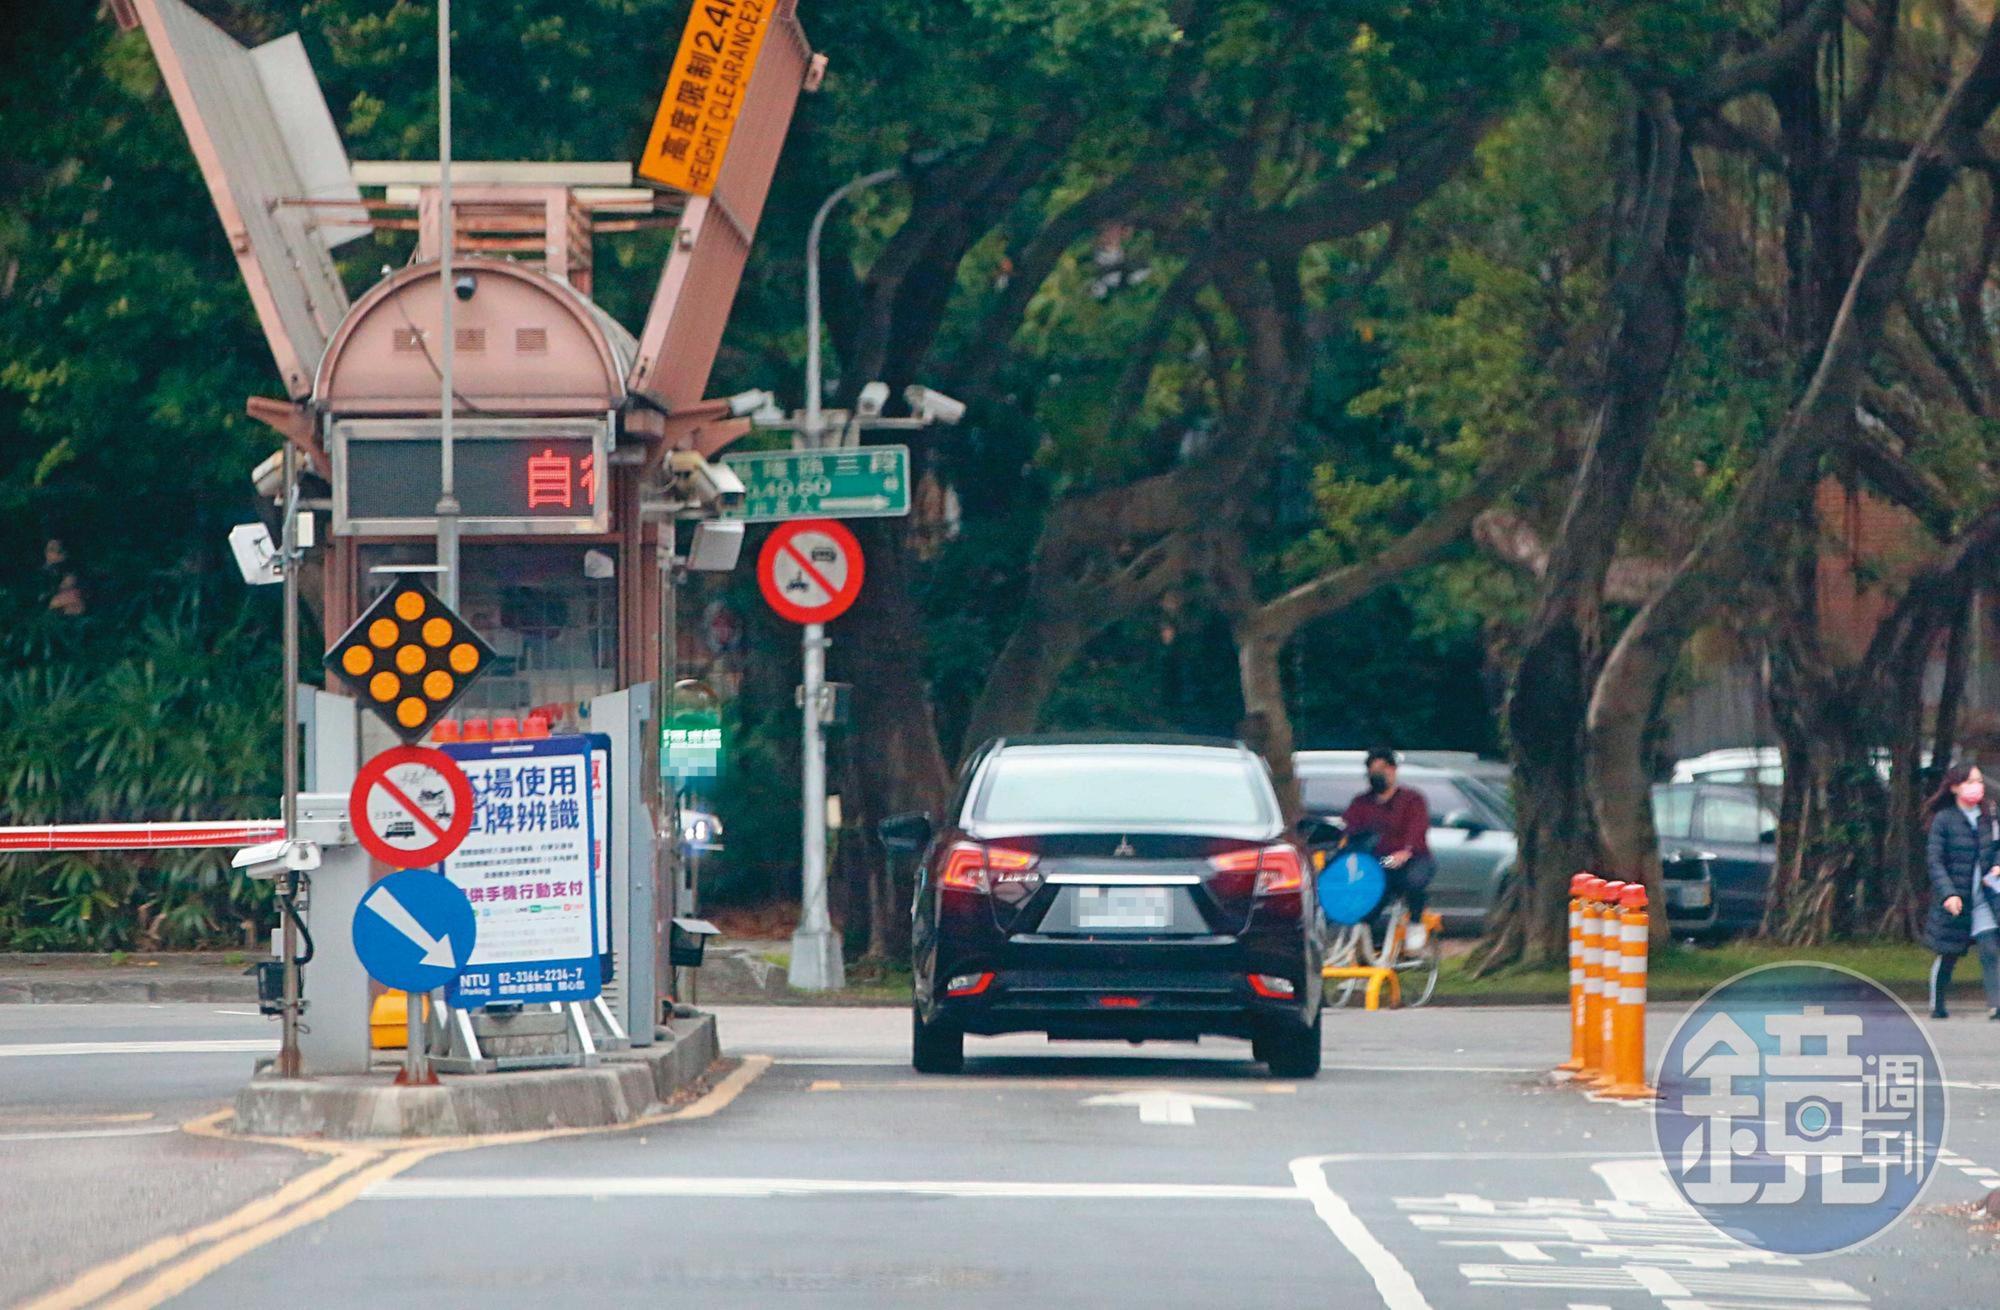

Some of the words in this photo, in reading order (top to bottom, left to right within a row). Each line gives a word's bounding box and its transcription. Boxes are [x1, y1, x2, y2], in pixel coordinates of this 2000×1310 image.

[661, 0, 736, 161] 高度限制2.4
[690, 122, 724, 188] HEIGHT
[461, 880, 583, 902] 供手機行動支付
[460, 974, 490, 987] NTU
